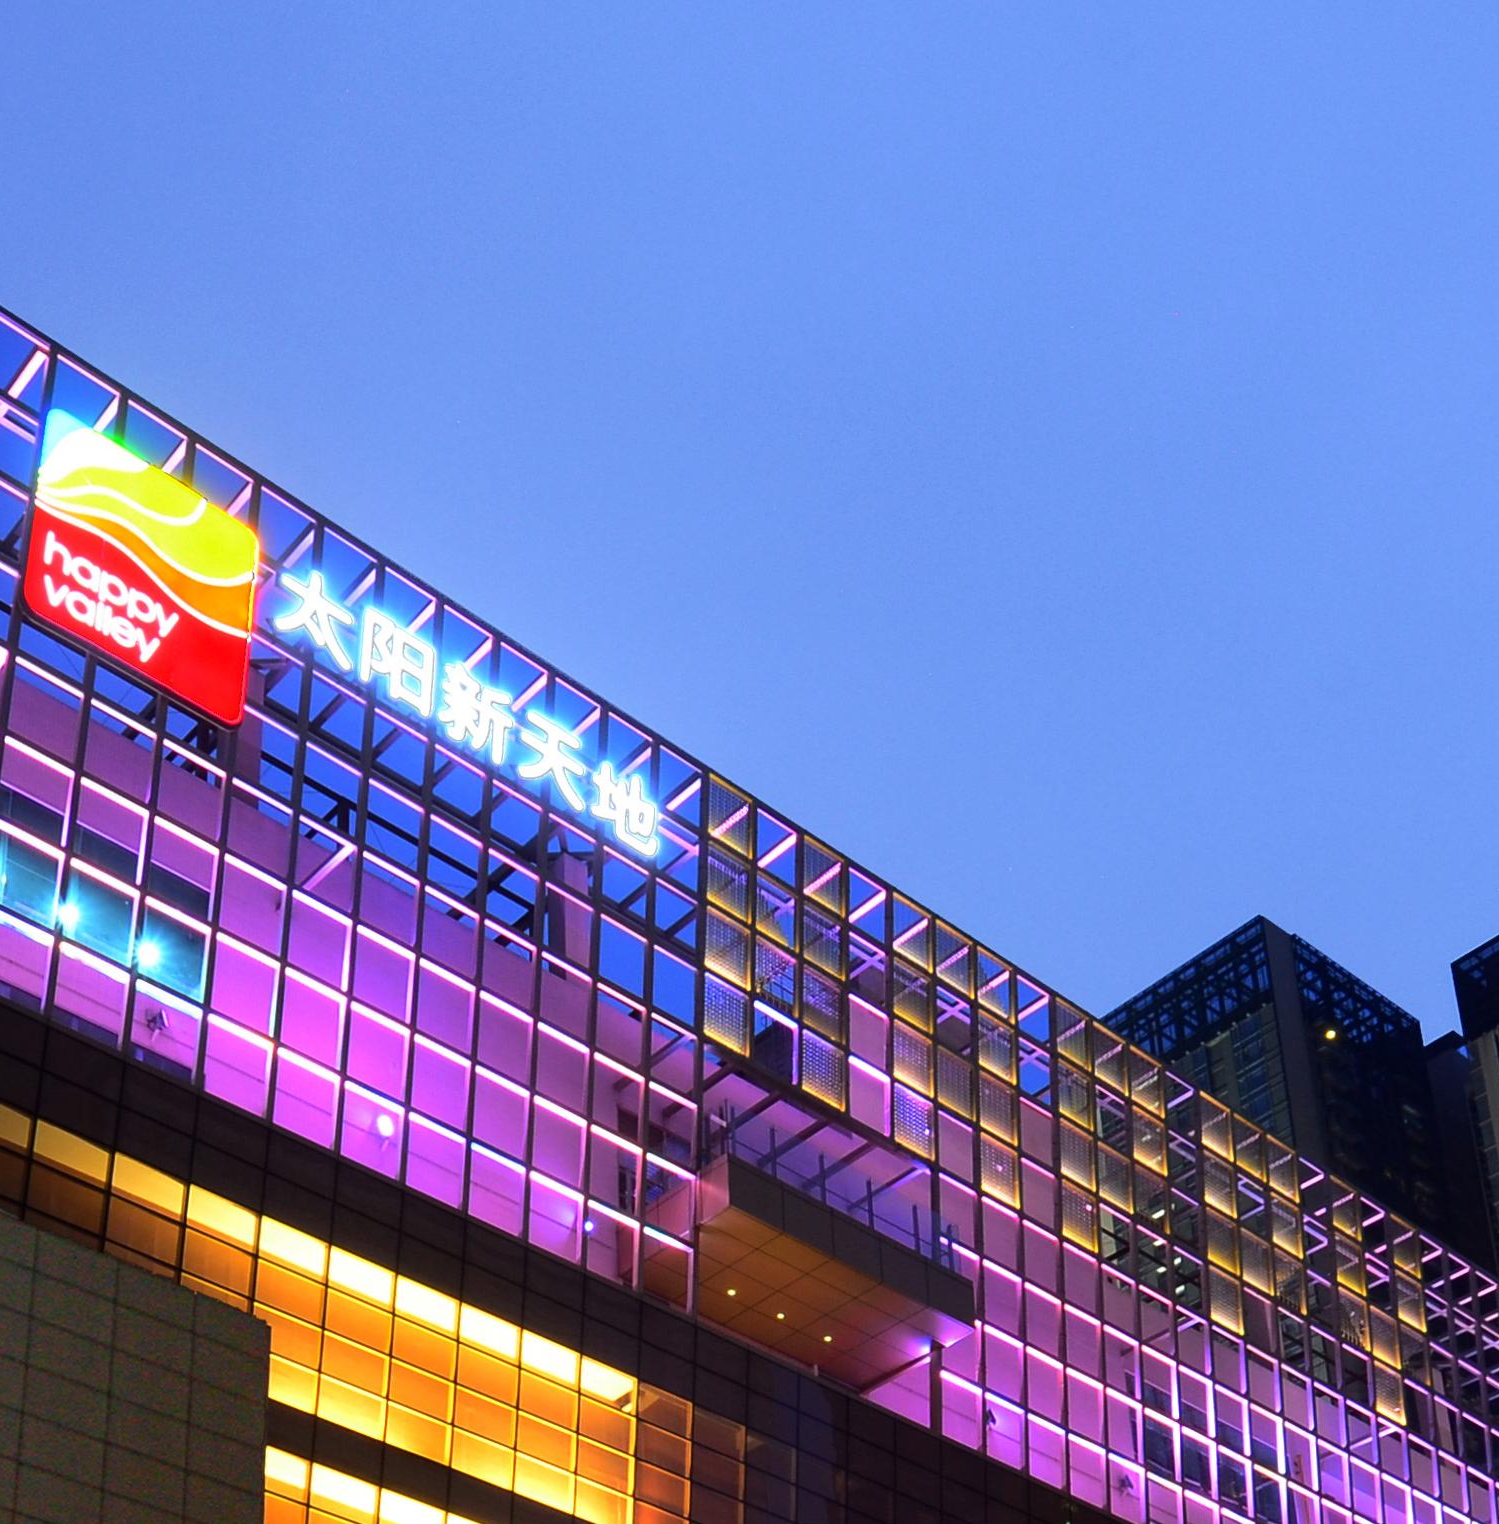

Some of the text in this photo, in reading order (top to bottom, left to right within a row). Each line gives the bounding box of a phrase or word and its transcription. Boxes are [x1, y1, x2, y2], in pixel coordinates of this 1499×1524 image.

[43, 531, 179, 638] happy
[43, 574, 161, 663] valley
[274, 570, 660, 858] 太阳新天地
